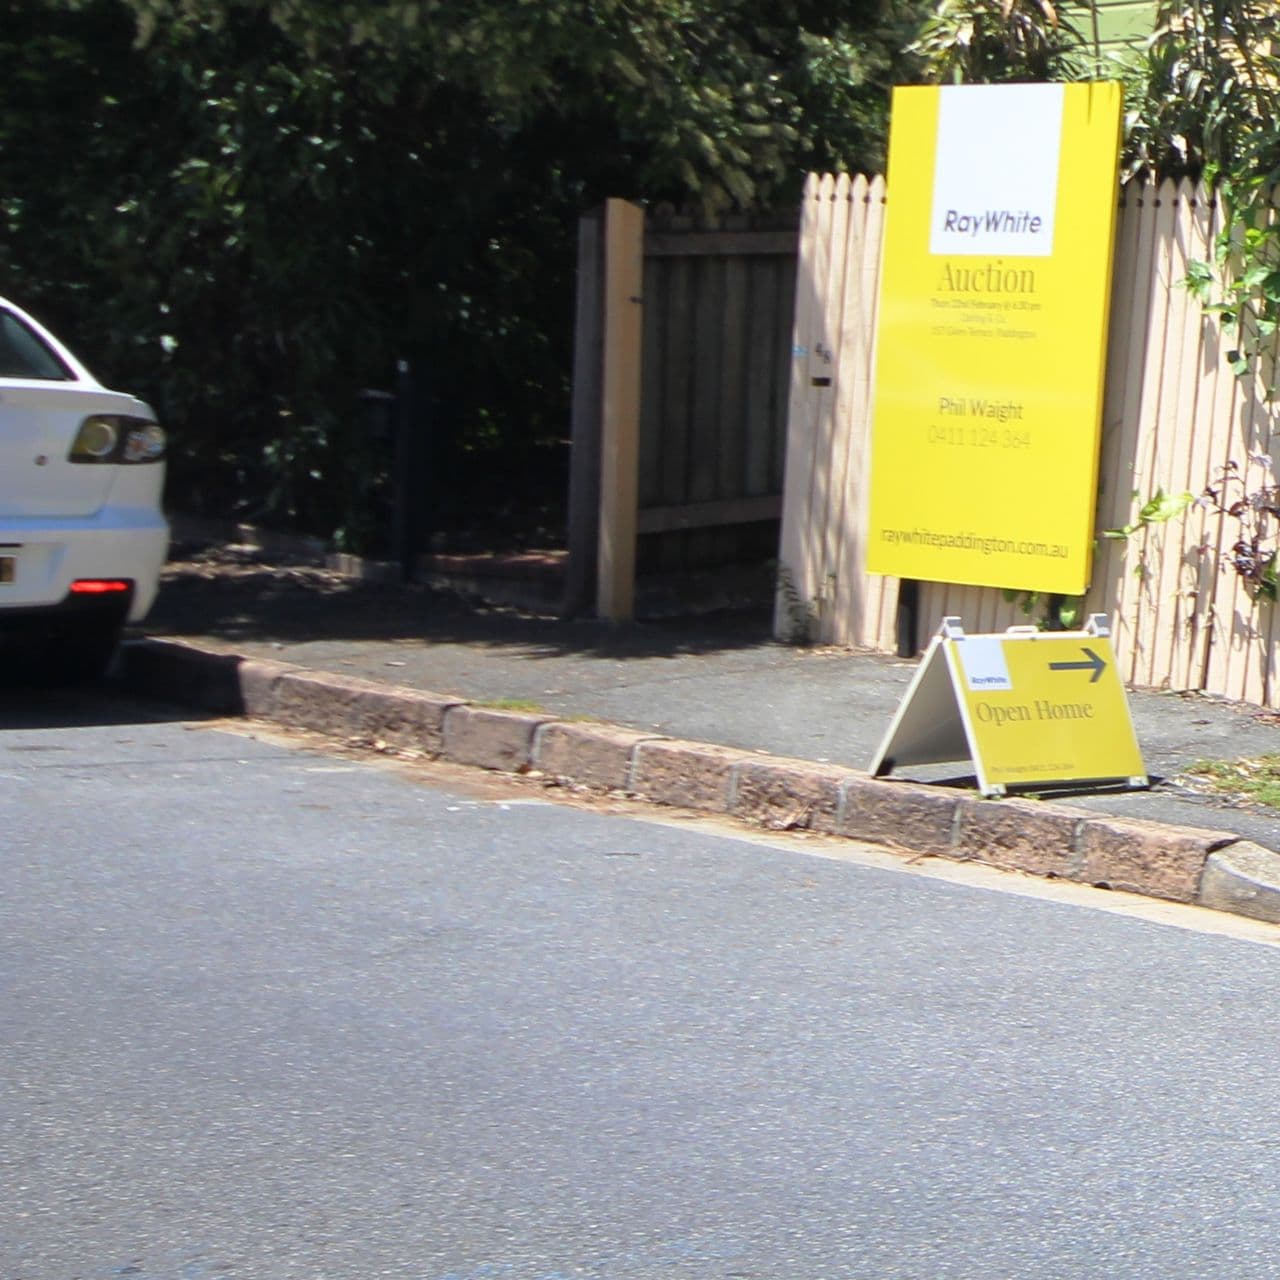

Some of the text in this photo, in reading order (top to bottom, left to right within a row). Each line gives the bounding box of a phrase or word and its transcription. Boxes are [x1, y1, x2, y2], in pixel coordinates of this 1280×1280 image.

[936, 259, 1035, 293] Auction
[938, 397, 1024, 423] Phil Waight
[880, 528, 1069, 559] raywhitepaddington.com.au
[976, 699, 1094, 726] Open Home
